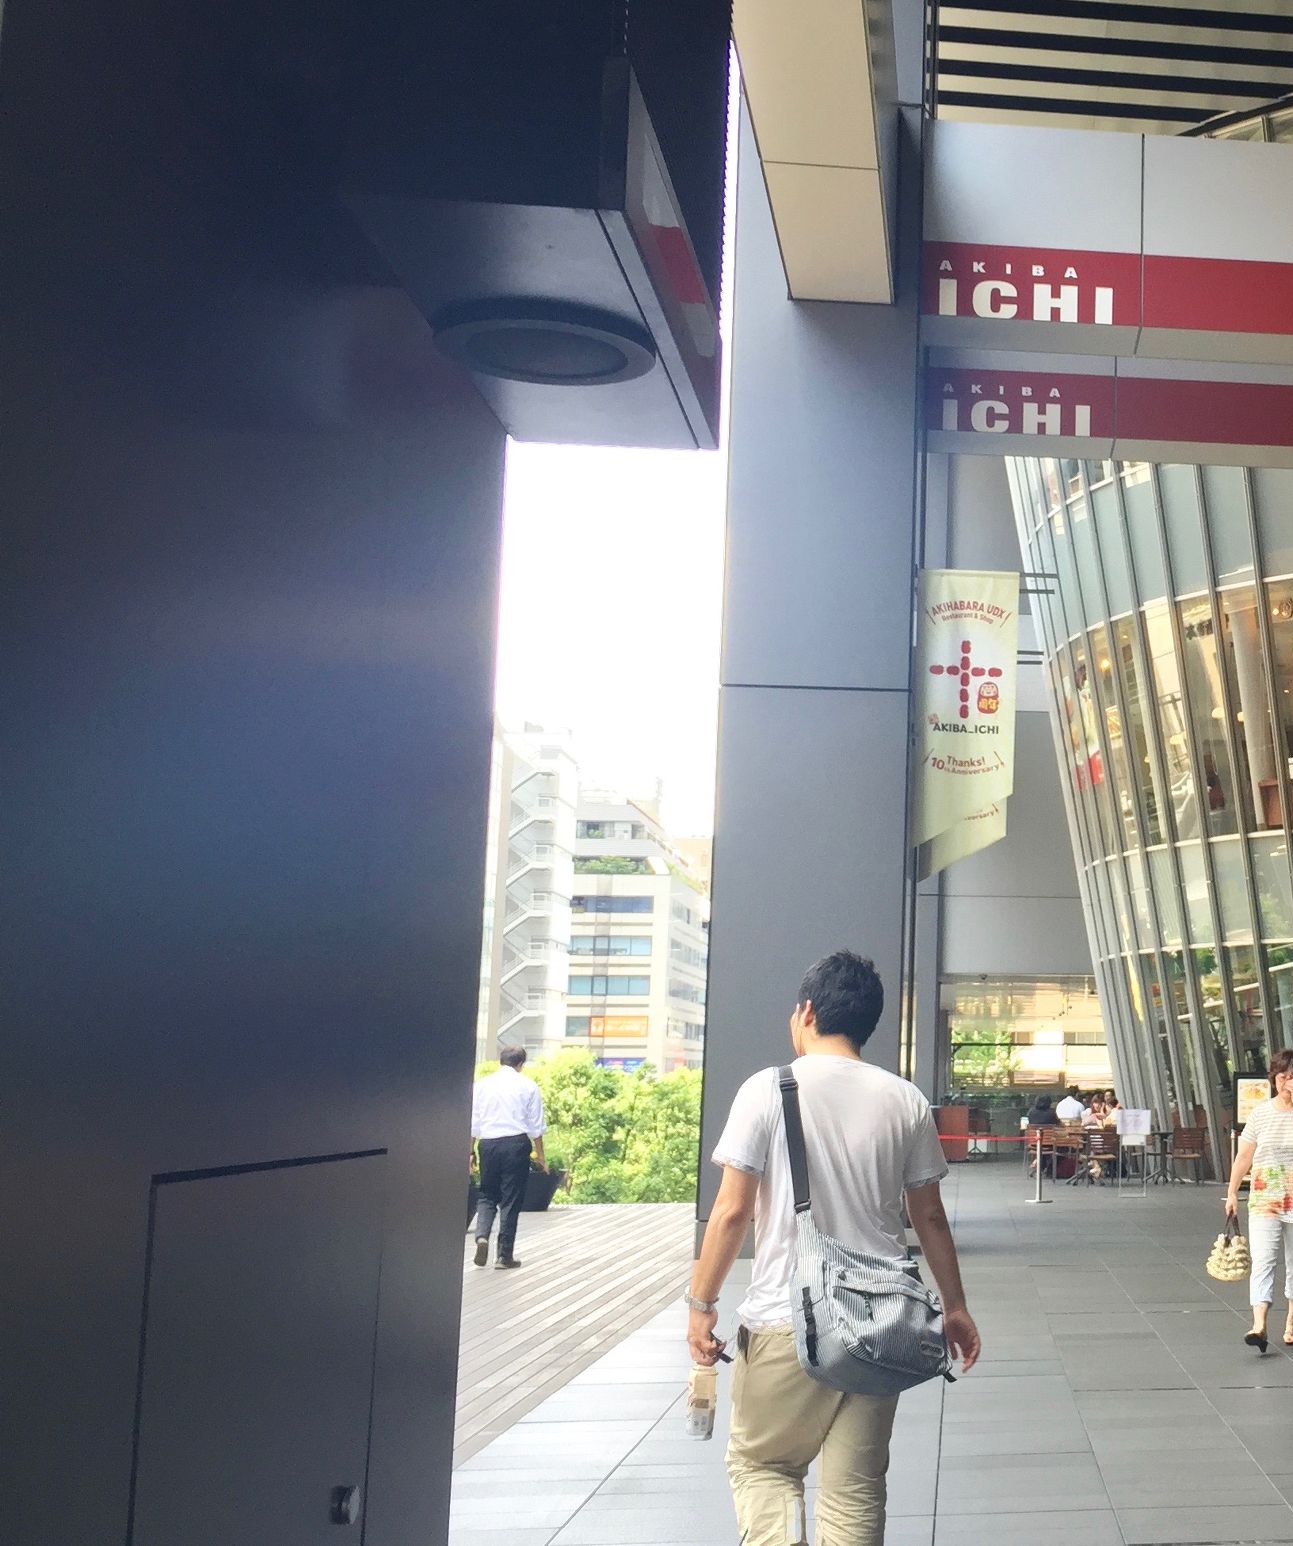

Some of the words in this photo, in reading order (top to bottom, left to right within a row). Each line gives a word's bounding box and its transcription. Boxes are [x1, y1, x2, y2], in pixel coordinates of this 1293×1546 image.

[939, 259, 1078, 279] AKIBA
[938, 278, 1114, 325] ICHI
[943, 383, 1061, 398] AKIBA
[942, 399, 1091, 437] ICHI
[931, 600, 985, 616] AKIHABARA
[987, 604, 1007, 619] UDX
[946, 755, 986, 767] Thanks!
